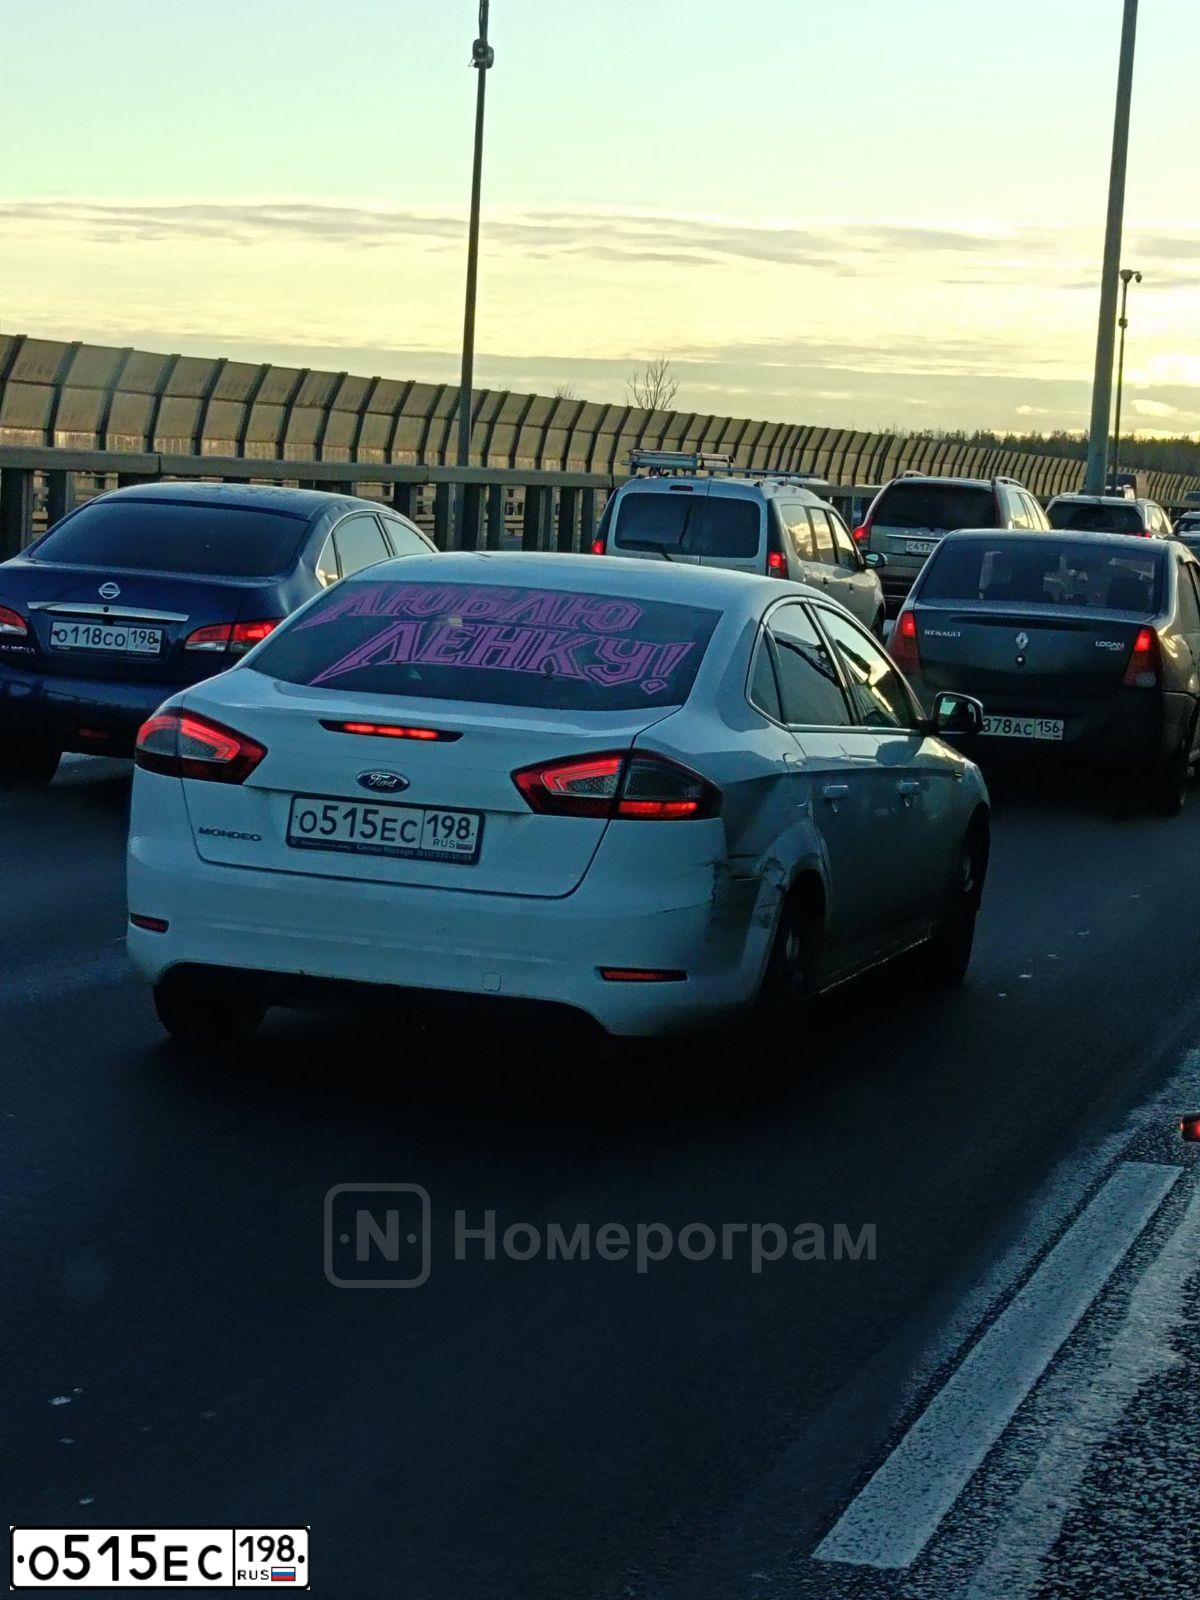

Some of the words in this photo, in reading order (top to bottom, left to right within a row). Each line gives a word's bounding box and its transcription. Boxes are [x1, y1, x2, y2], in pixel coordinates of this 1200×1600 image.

[292, 583, 644, 633] ЛЮБЛЮ
[130, 629, 156, 644] 198
[924, 629, 961, 637] RENAULT
[1095, 640, 1125, 650] LOGAN
[307, 620, 697, 696] ЛЕНКУ!
[982, 718, 1033, 735] 378АС
[1037, 721, 1060, 733] 156
[369, 773, 397, 788] Ford
[299, 805, 418, 843] О515ЕС
[426, 814, 471, 840] 198
[199, 826, 262, 842] MONDEO
[433, 838, 455, 848] RUS
